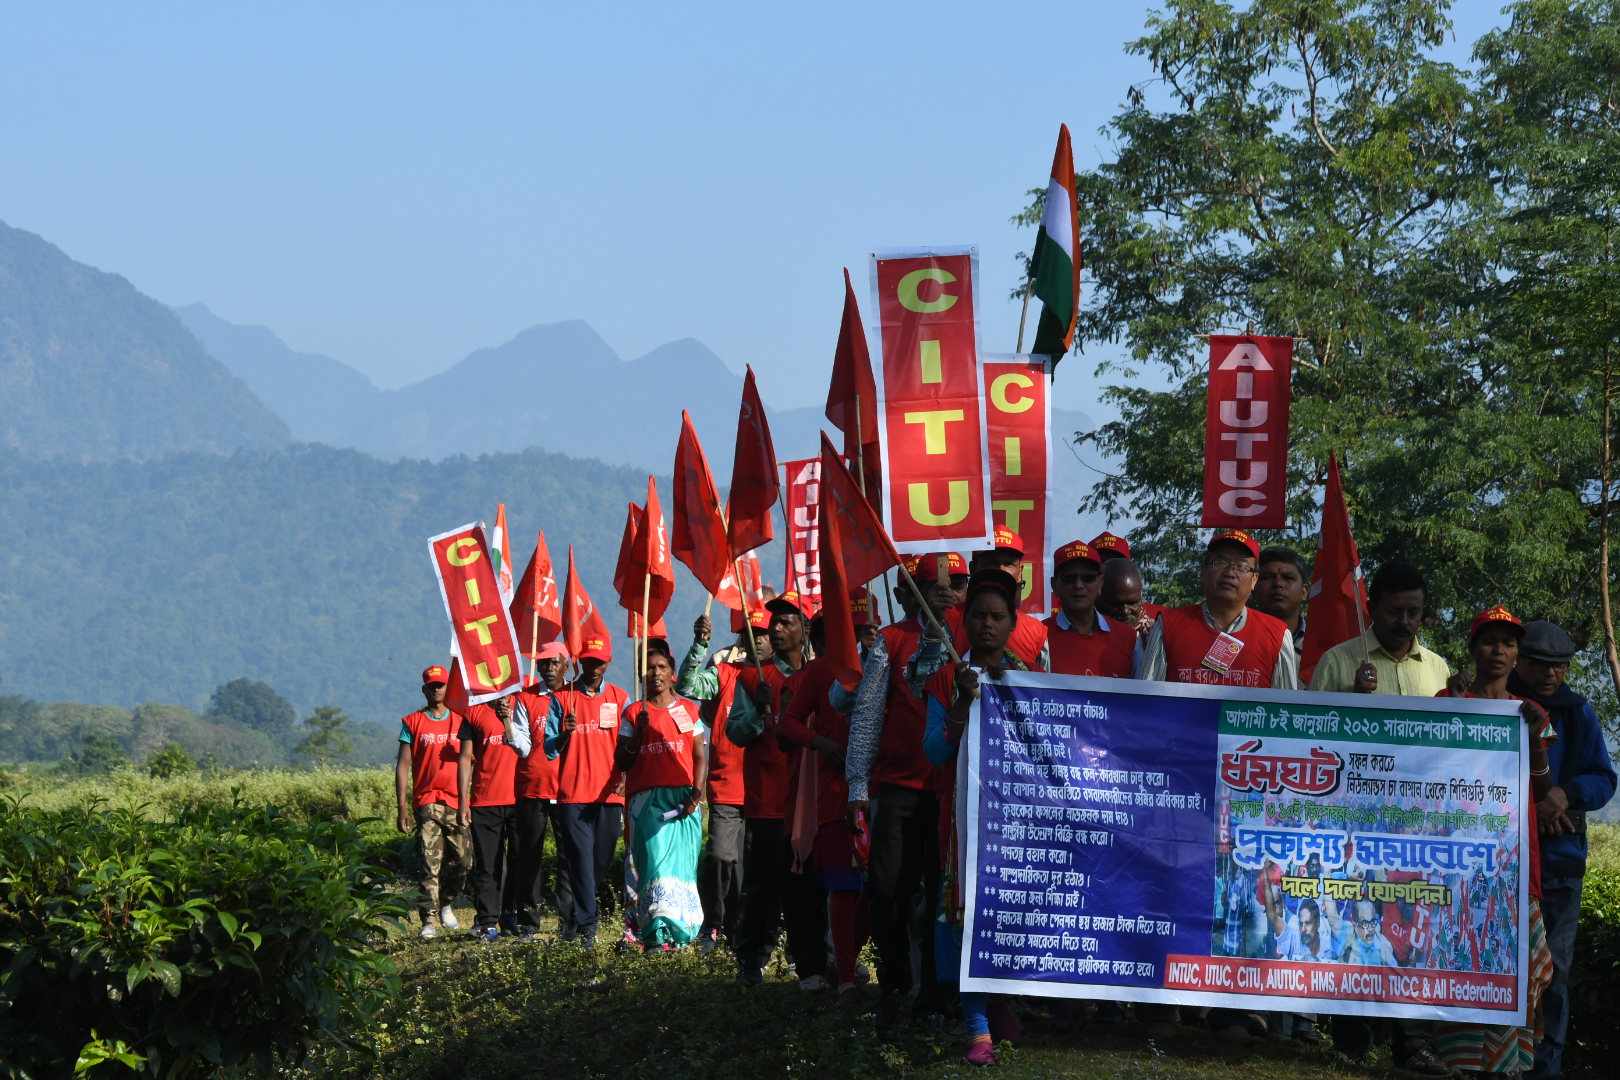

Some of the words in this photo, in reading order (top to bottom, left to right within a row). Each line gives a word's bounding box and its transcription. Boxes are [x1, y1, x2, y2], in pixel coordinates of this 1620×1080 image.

[897, 268, 970, 526] CITU
[1217, 343, 1274, 517] AIUTUC
[1066, 550, 1088, 558] CITU
[446, 537, 512, 687] CITU
[1067, 704, 1081, 718] দেশ
[1225, 706, 1267, 729] আগামী
[1270, 708, 1290, 732] ৮ই
[1291, 710, 1340, 736] জানুয়ারি
[1343, 716, 1380, 738] ২০২০
[1383, 717, 1464, 741] সারাদেশব্যাপী
[1467, 722, 1512, 744] সাধারণ
[1054, 742, 1066, 758] চাই
[1348, 752, 1368, 770] সফল
[1371, 754, 1395, 772] করতে
[1003, 761, 1011, 775] চা
[1014, 761, 1035, 776] বাগান
[1221, 740, 1341, 794] ধর্মঘট
[1003, 782, 1011, 796] চা
[1013, 783, 1036, 798] বাগান
[1187, 792, 1201, 810] চাই
[1388, 779, 1397, 797] চা
[1399, 779, 1422, 799] বাগান
[1424, 782, 1447, 801] থেকে
[1450, 778, 1484, 805] শিলিগুড়ি
[1235, 828, 1346, 865] প্রকাশ্য
[1354, 835, 1497, 873] সমাবেশে
[1065, 890, 1079, 908] চাই
[1281, 876, 1321, 900] দলে
[1324, 878, 1363, 901] দলে
[1168, 962, 1201, 987] INTUC,
[1205, 964, 1234, 990] UTUC,
[1237, 966, 1263, 991] CITU,
[1266, 968, 1307, 994] AIUTUC,
[1311, 970, 1338, 996] HMS,
[1340, 972, 1385, 998] AICCTU,
[1388, 975, 1419, 998] TUCC
[1422, 977, 1431, 998] &
[1433, 978, 1446, 999] All
[1449, 979, 1512, 1004] Federations
